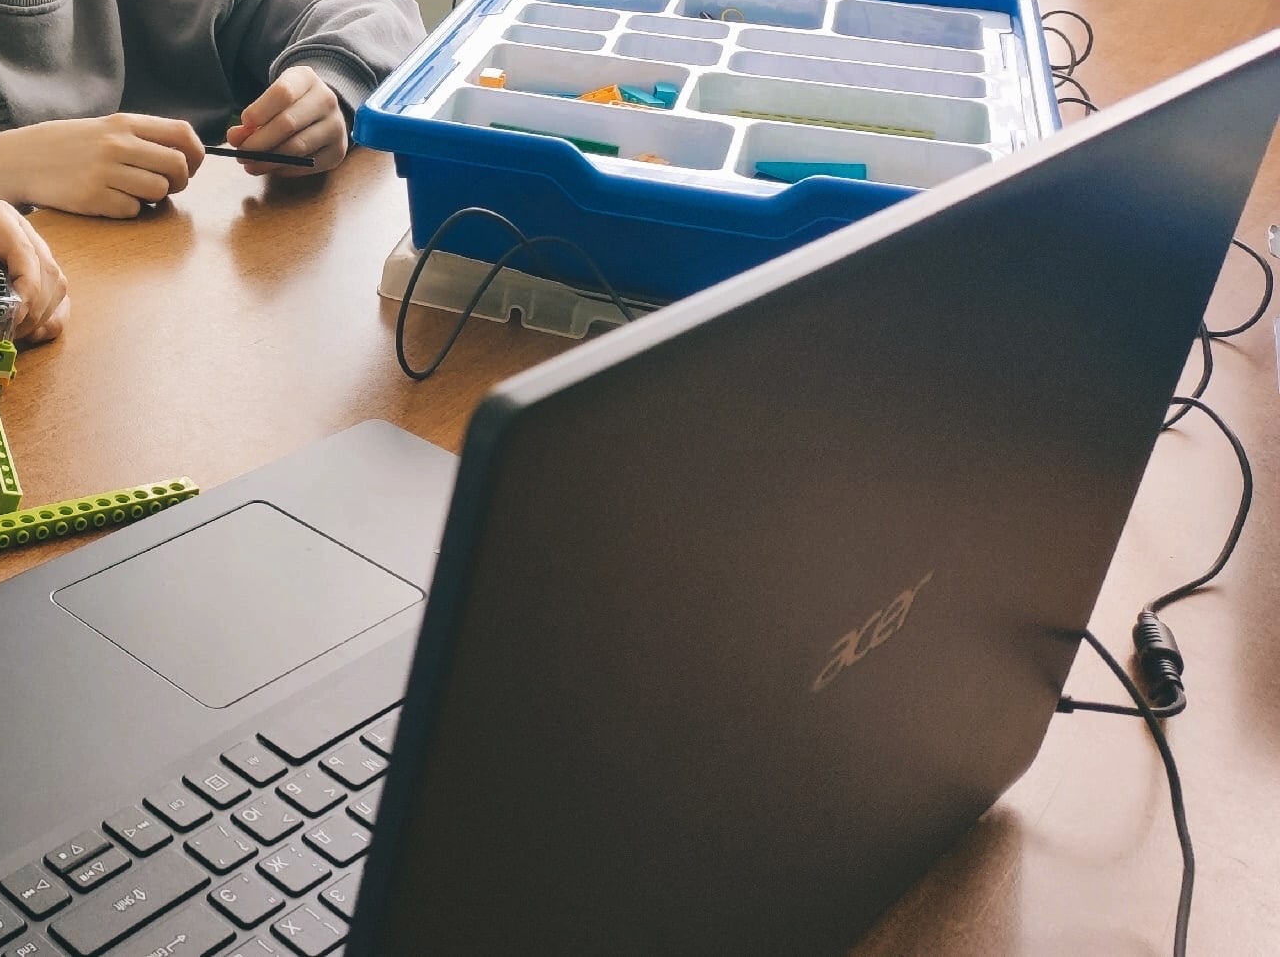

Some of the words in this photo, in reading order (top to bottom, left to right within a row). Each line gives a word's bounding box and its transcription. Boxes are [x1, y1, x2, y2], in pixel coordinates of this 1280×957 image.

[811, 568, 935, 692] acer
[265, 855, 289, 873] Ж
[112, 894, 137, 912] Shift
